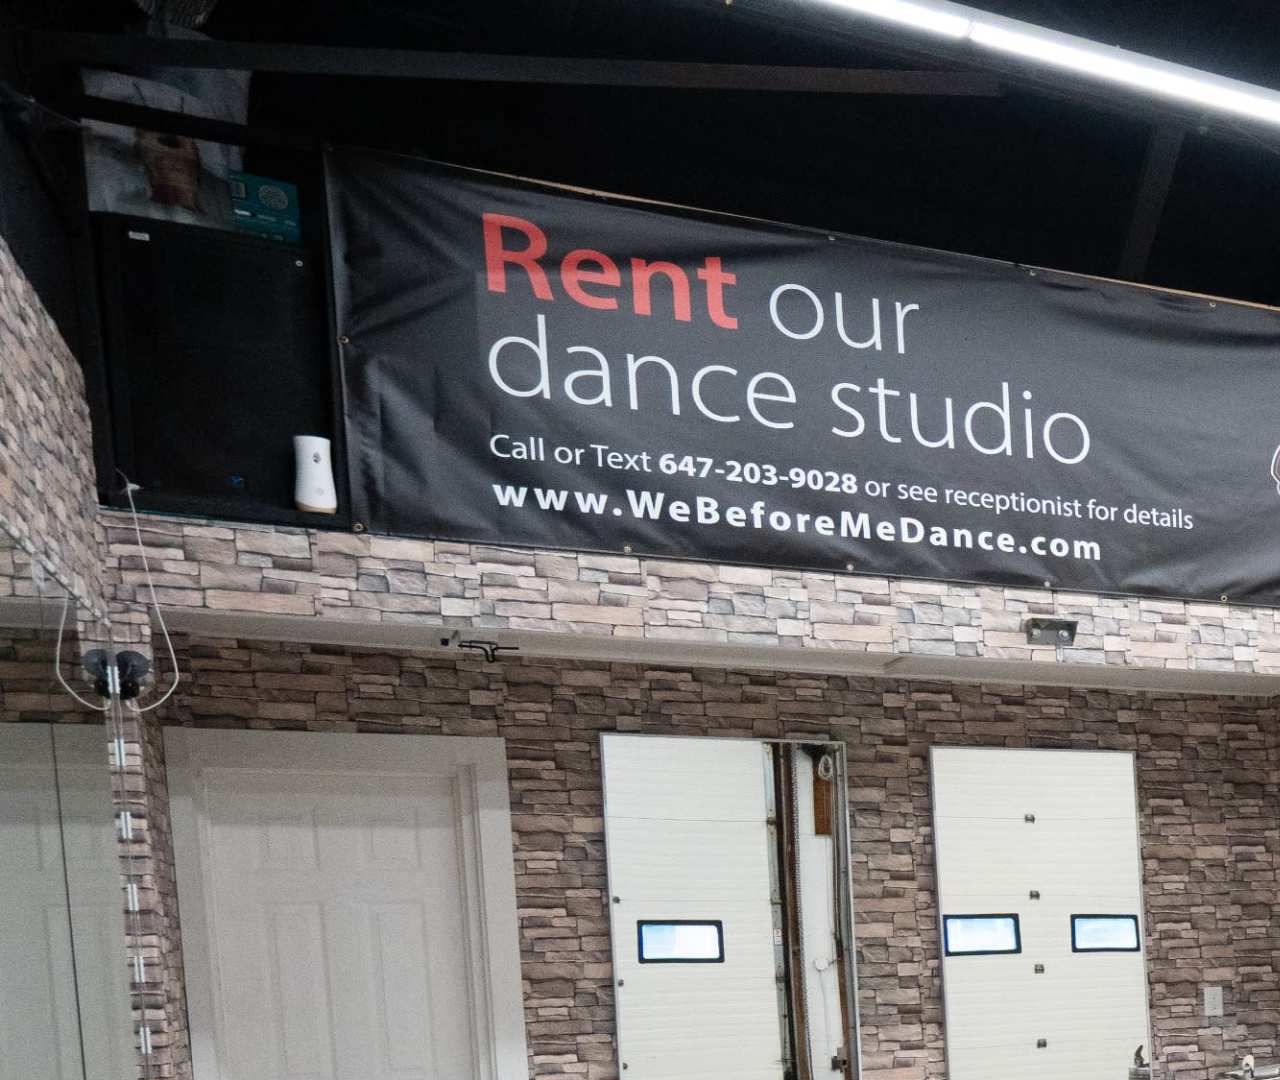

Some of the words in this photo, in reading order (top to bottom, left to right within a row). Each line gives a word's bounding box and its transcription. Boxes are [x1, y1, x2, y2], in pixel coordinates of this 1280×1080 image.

[482, 212, 738, 330] Rent
[769, 283, 919, 354] our
[488, 314, 797, 429] dance
[831, 378, 1090, 465] studio
[490, 434, 545, 462] Call
[554, 446, 585, 466] or
[590, 444, 653, 473] Text
[659, 453, 859, 494] 647-203-9028
[864, 480, 891, 498] or
[898, 483, 938, 503] see
[945, 487, 1083, 518] receptionist
[1087, 499, 1119, 521] for
[1123, 504, 1194, 530] details
[492, 484, 1102, 561] www.WeBeforeMeDance.com
